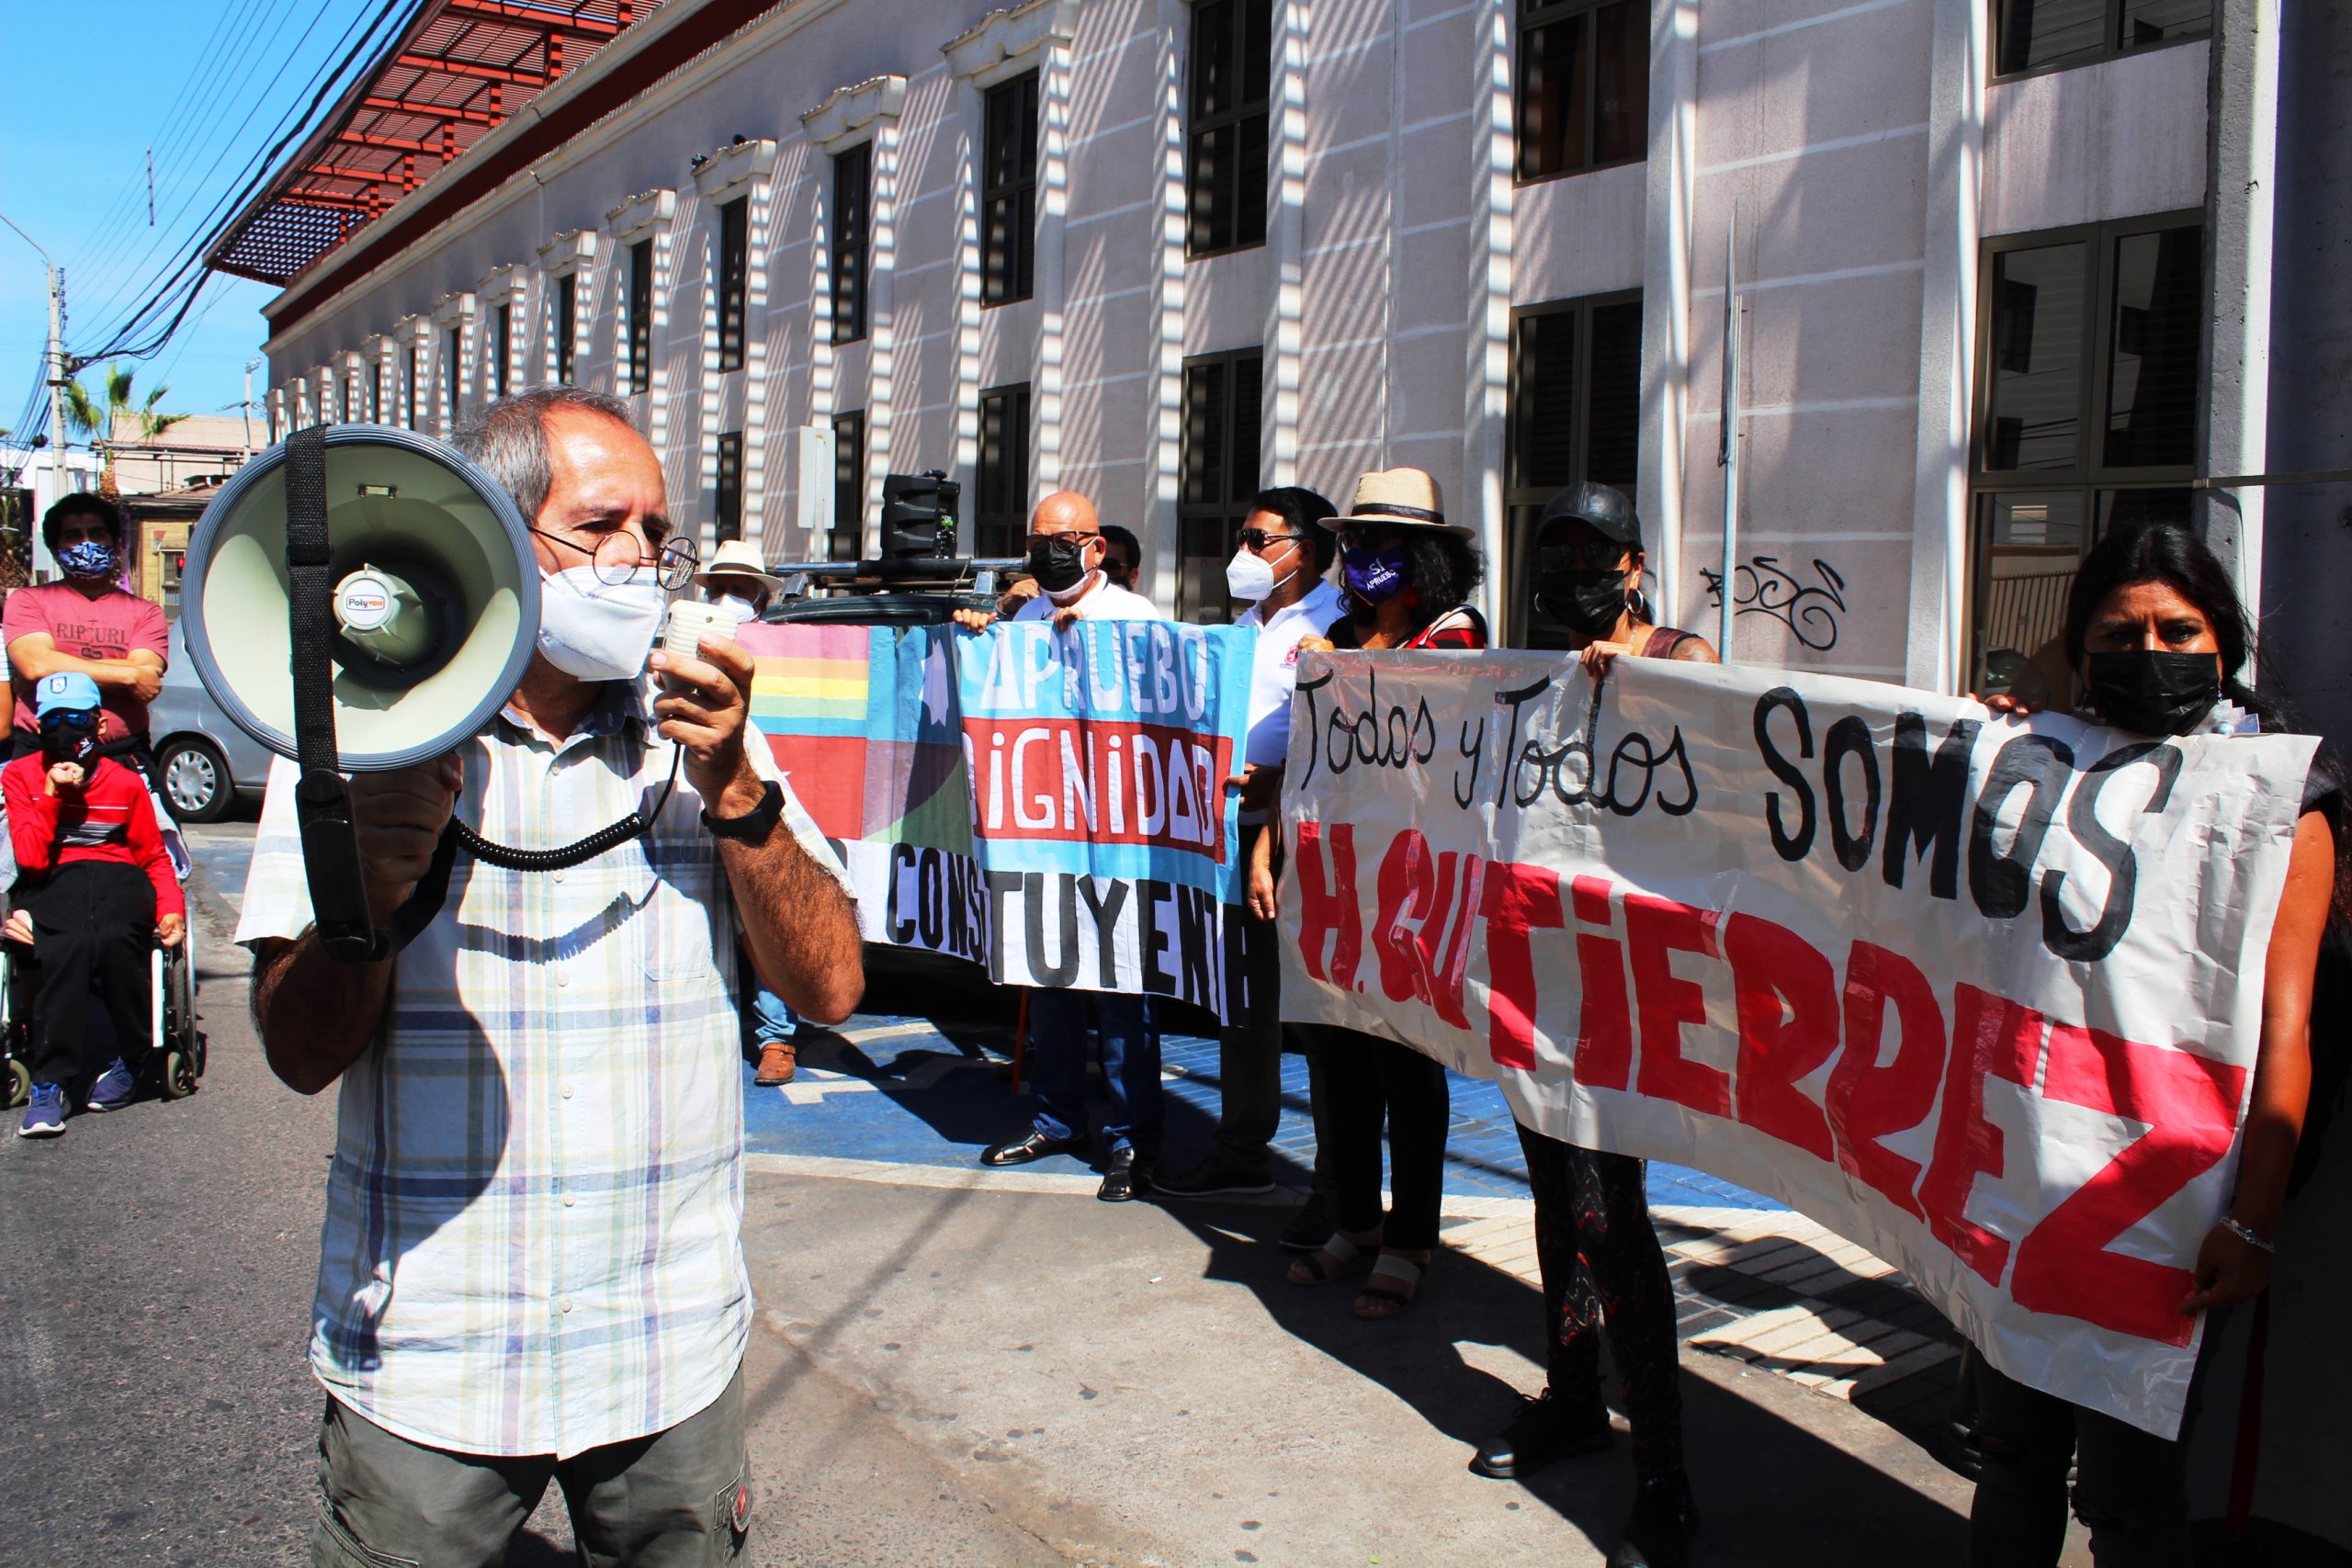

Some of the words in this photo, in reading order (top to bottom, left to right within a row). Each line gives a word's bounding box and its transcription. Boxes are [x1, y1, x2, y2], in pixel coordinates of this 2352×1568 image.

[348, 598, 383, 609] Polyvox
[1366, 569, 1396, 591] APRUEBO
[980, 624, 1210, 721] APRUEBO
[1295, 664, 1437, 791] Todos
[1454, 715, 1485, 810] y
[1493, 674, 1699, 817] Todos
[1752, 685, 2183, 963] SOMOS
